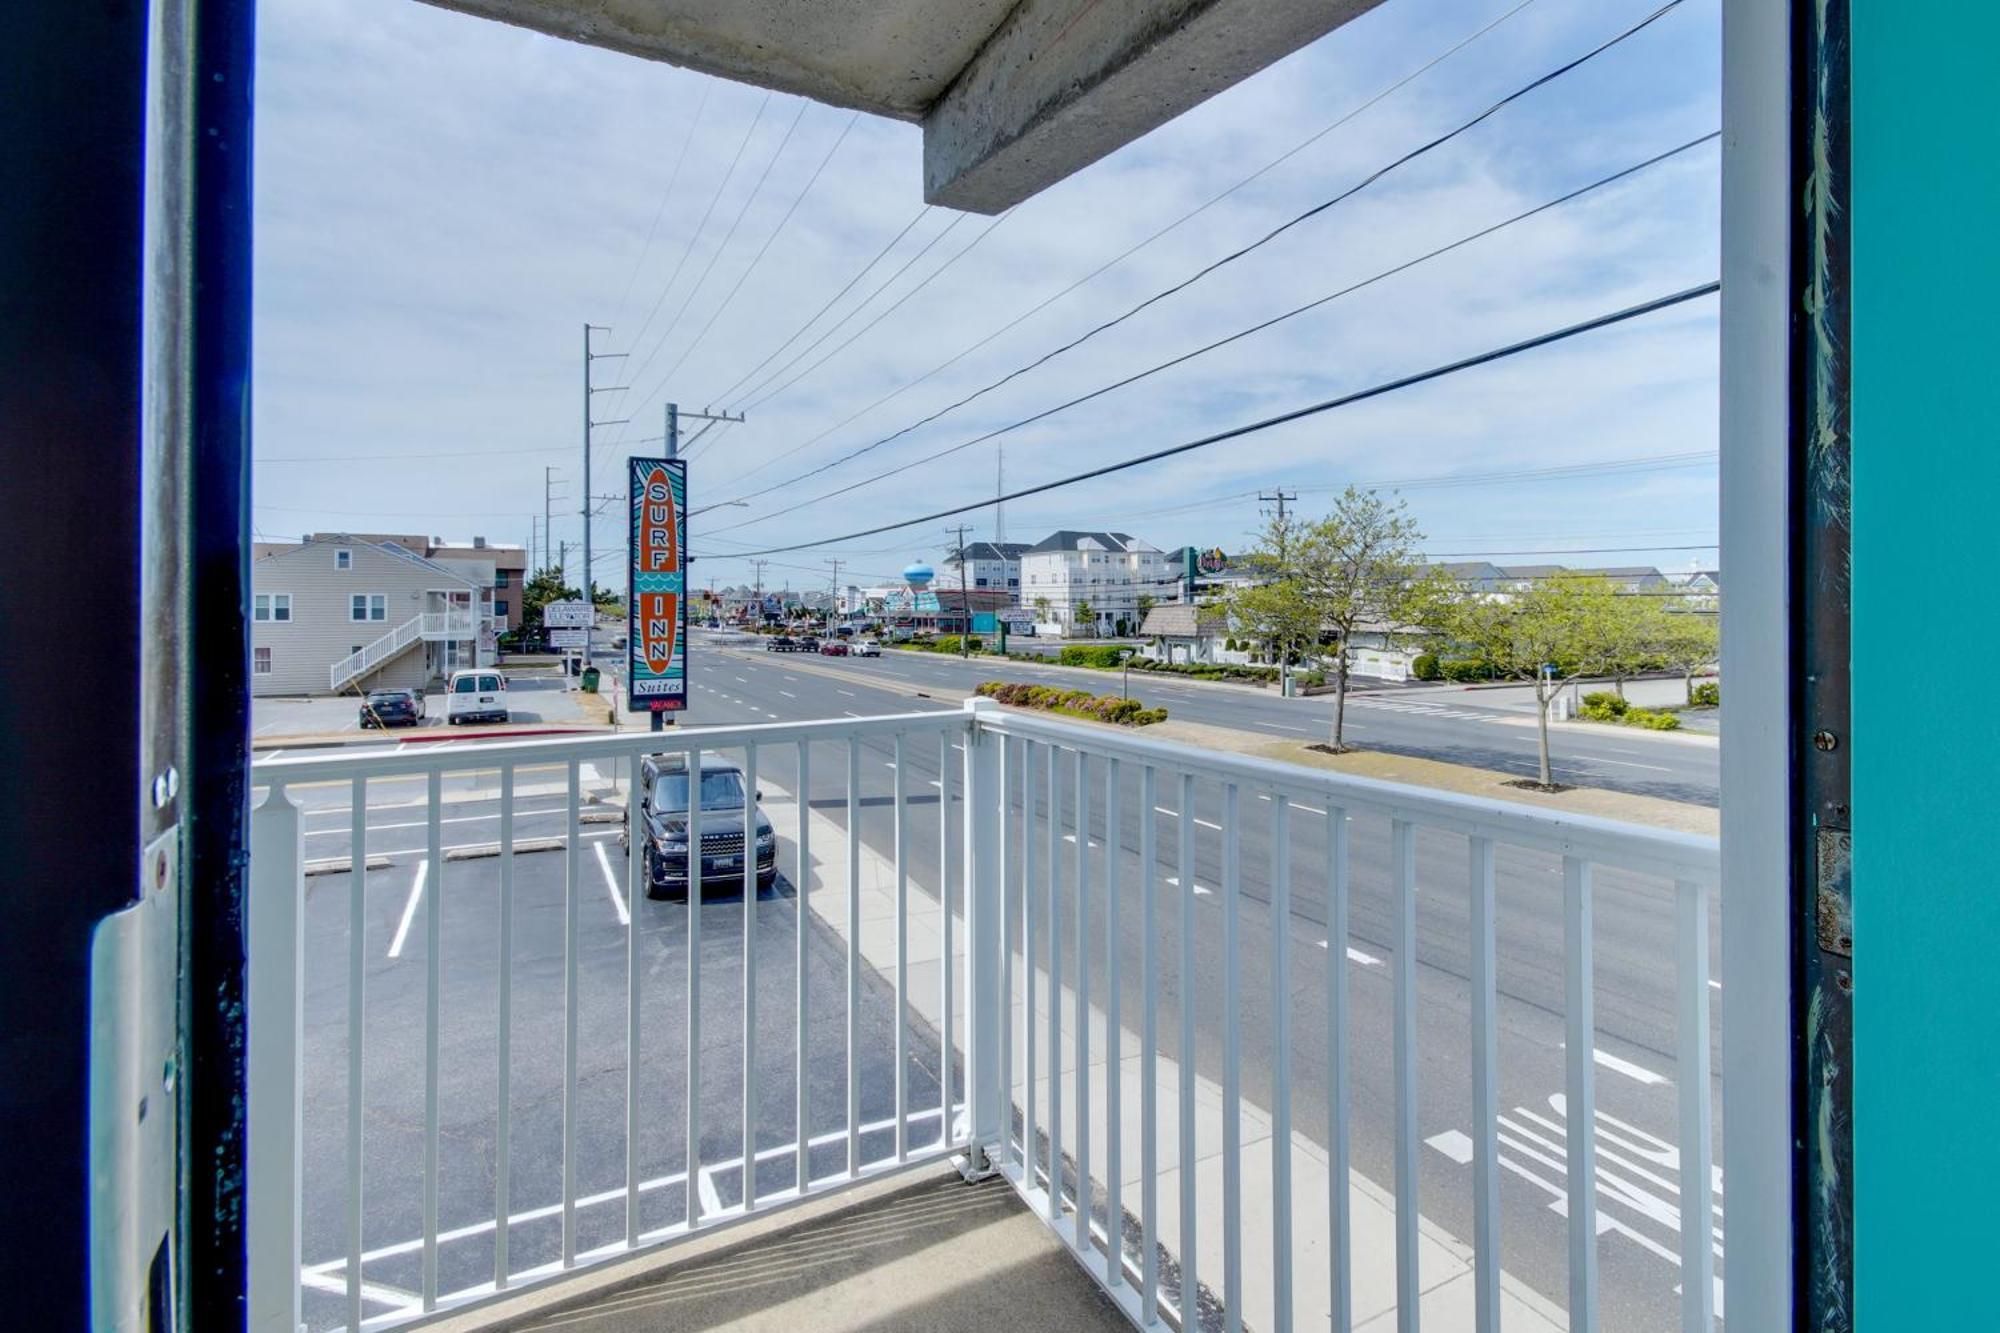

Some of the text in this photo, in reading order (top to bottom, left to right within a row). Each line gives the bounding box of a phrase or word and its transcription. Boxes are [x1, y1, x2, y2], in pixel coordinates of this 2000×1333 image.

[650, 484, 669, 569] SURF
[649, 596, 668, 661] INN
[639, 681, 680, 693] Suites
